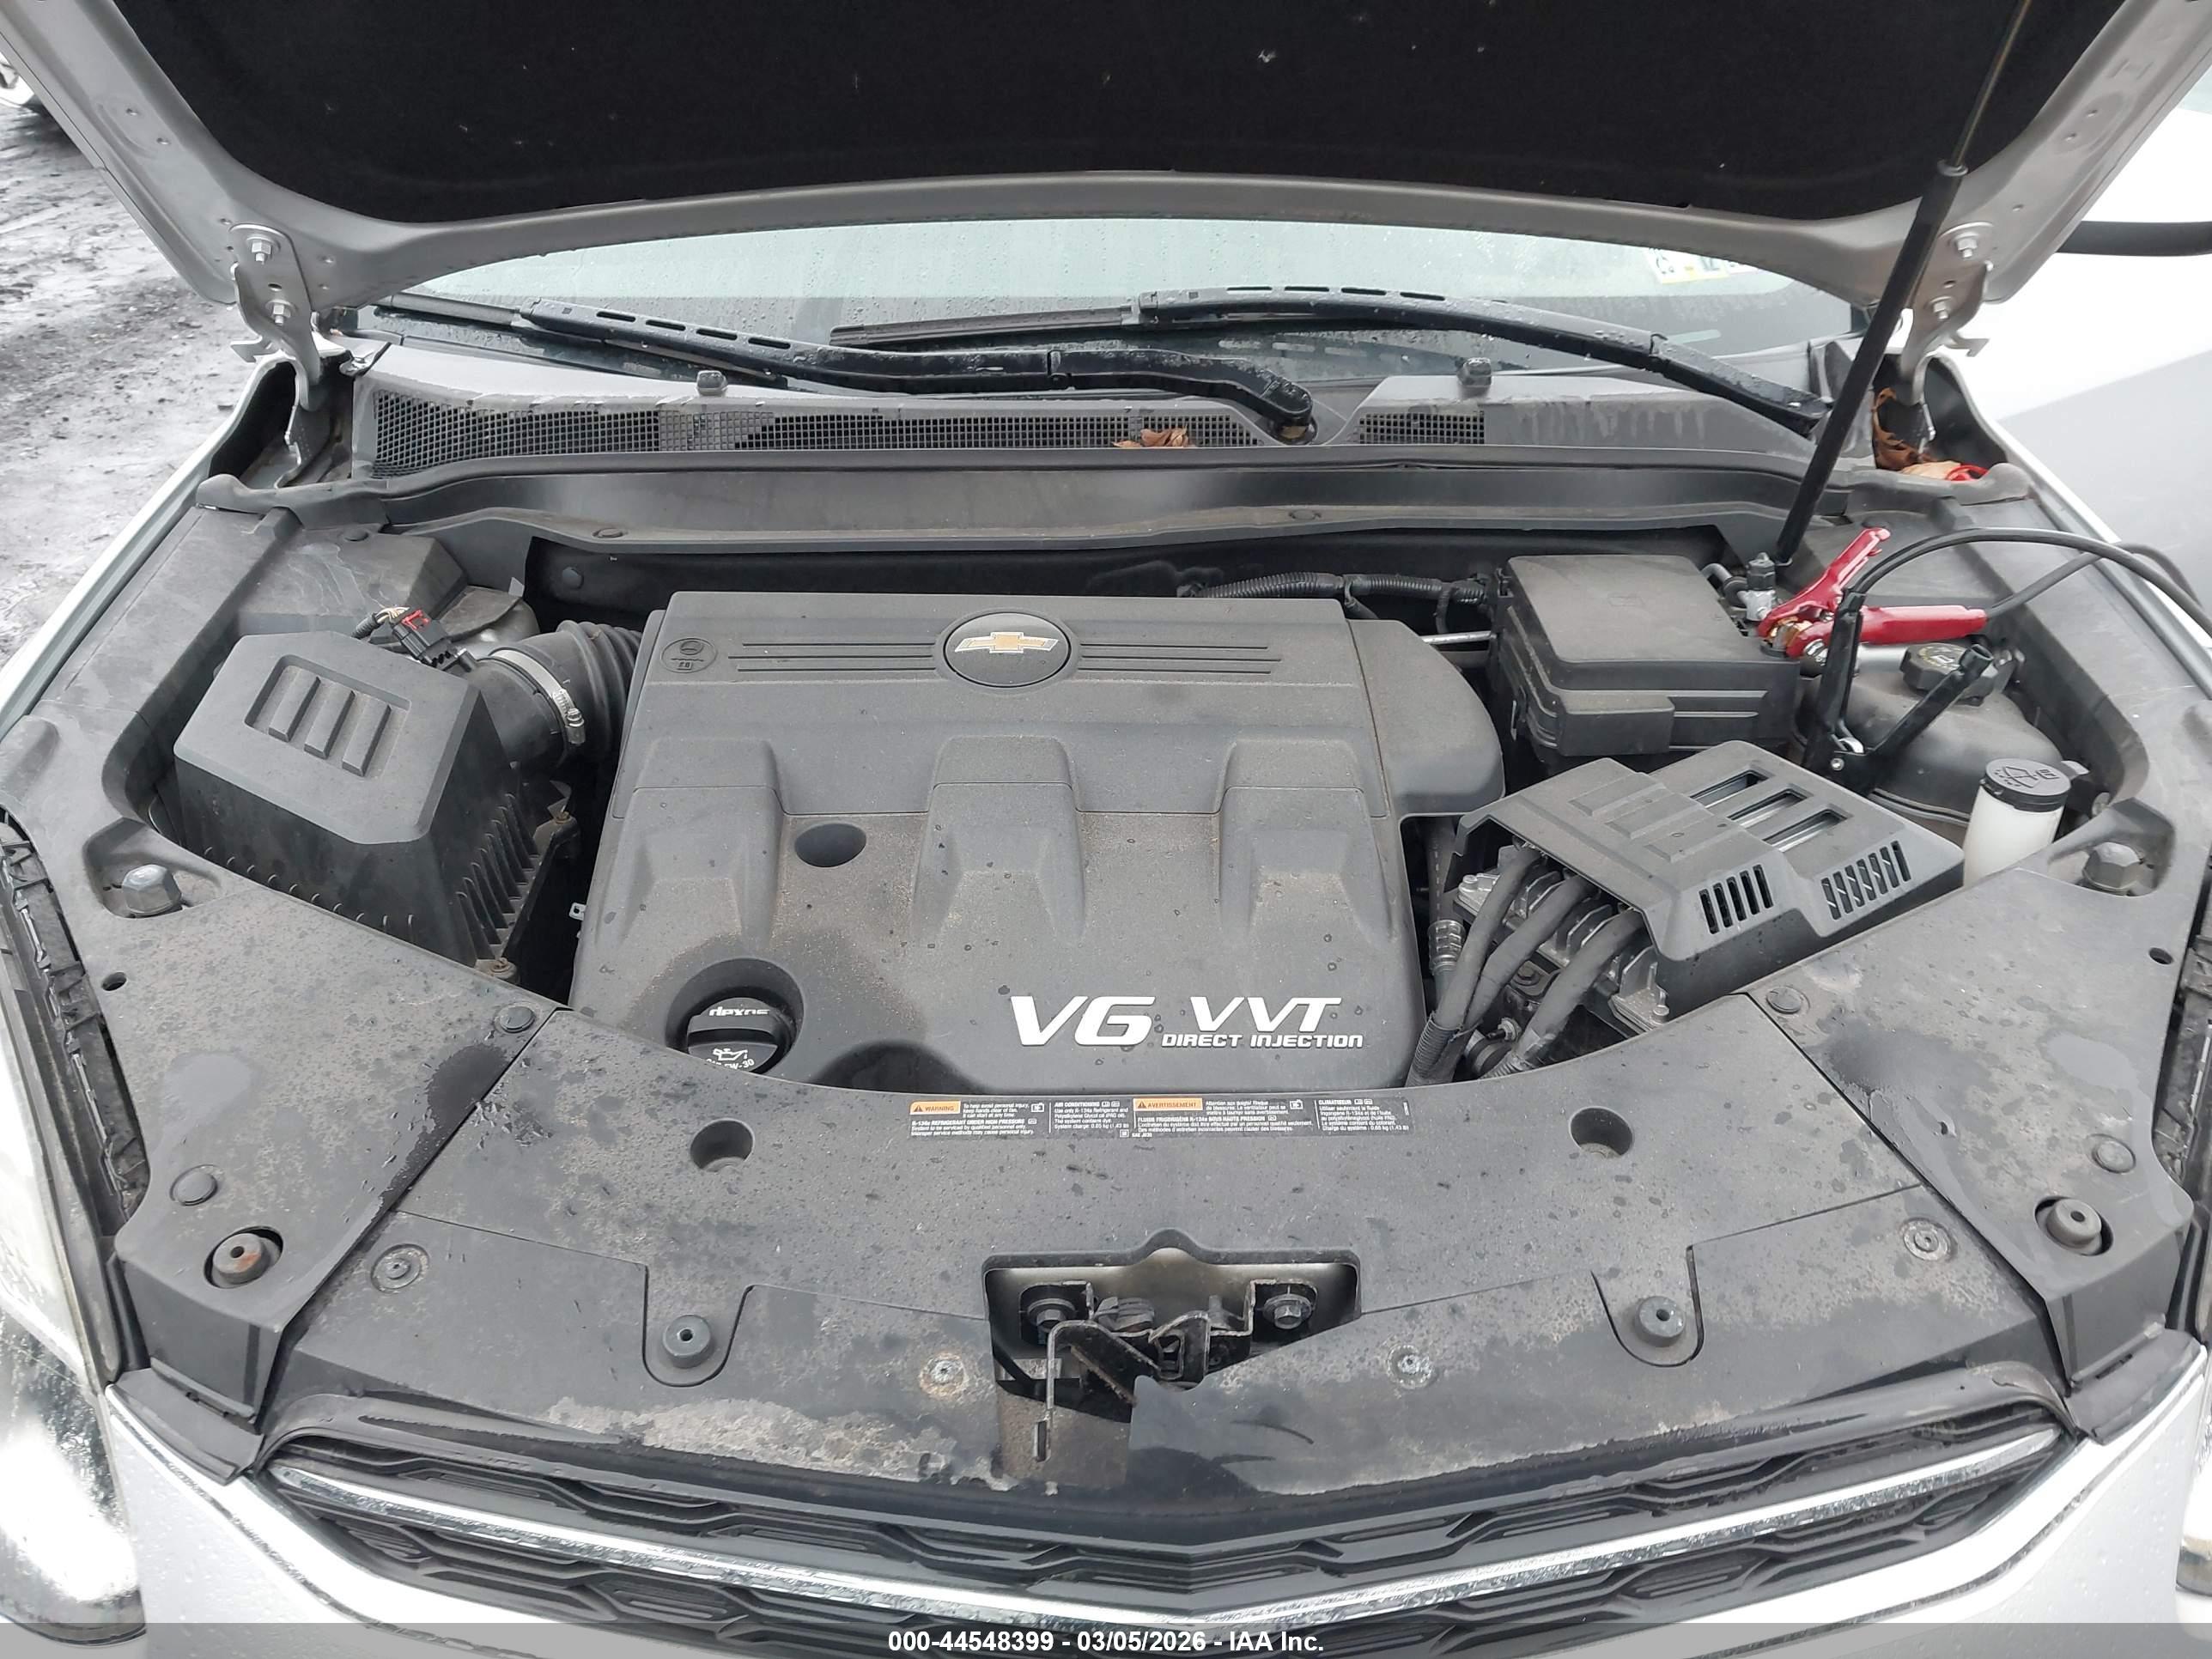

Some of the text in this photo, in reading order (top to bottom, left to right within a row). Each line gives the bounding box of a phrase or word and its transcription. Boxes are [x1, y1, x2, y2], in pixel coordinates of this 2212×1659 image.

[1011, 996, 1342, 1046] V6 VVT
[1162, 1034, 1364, 1048] DIRECT INJECTION
